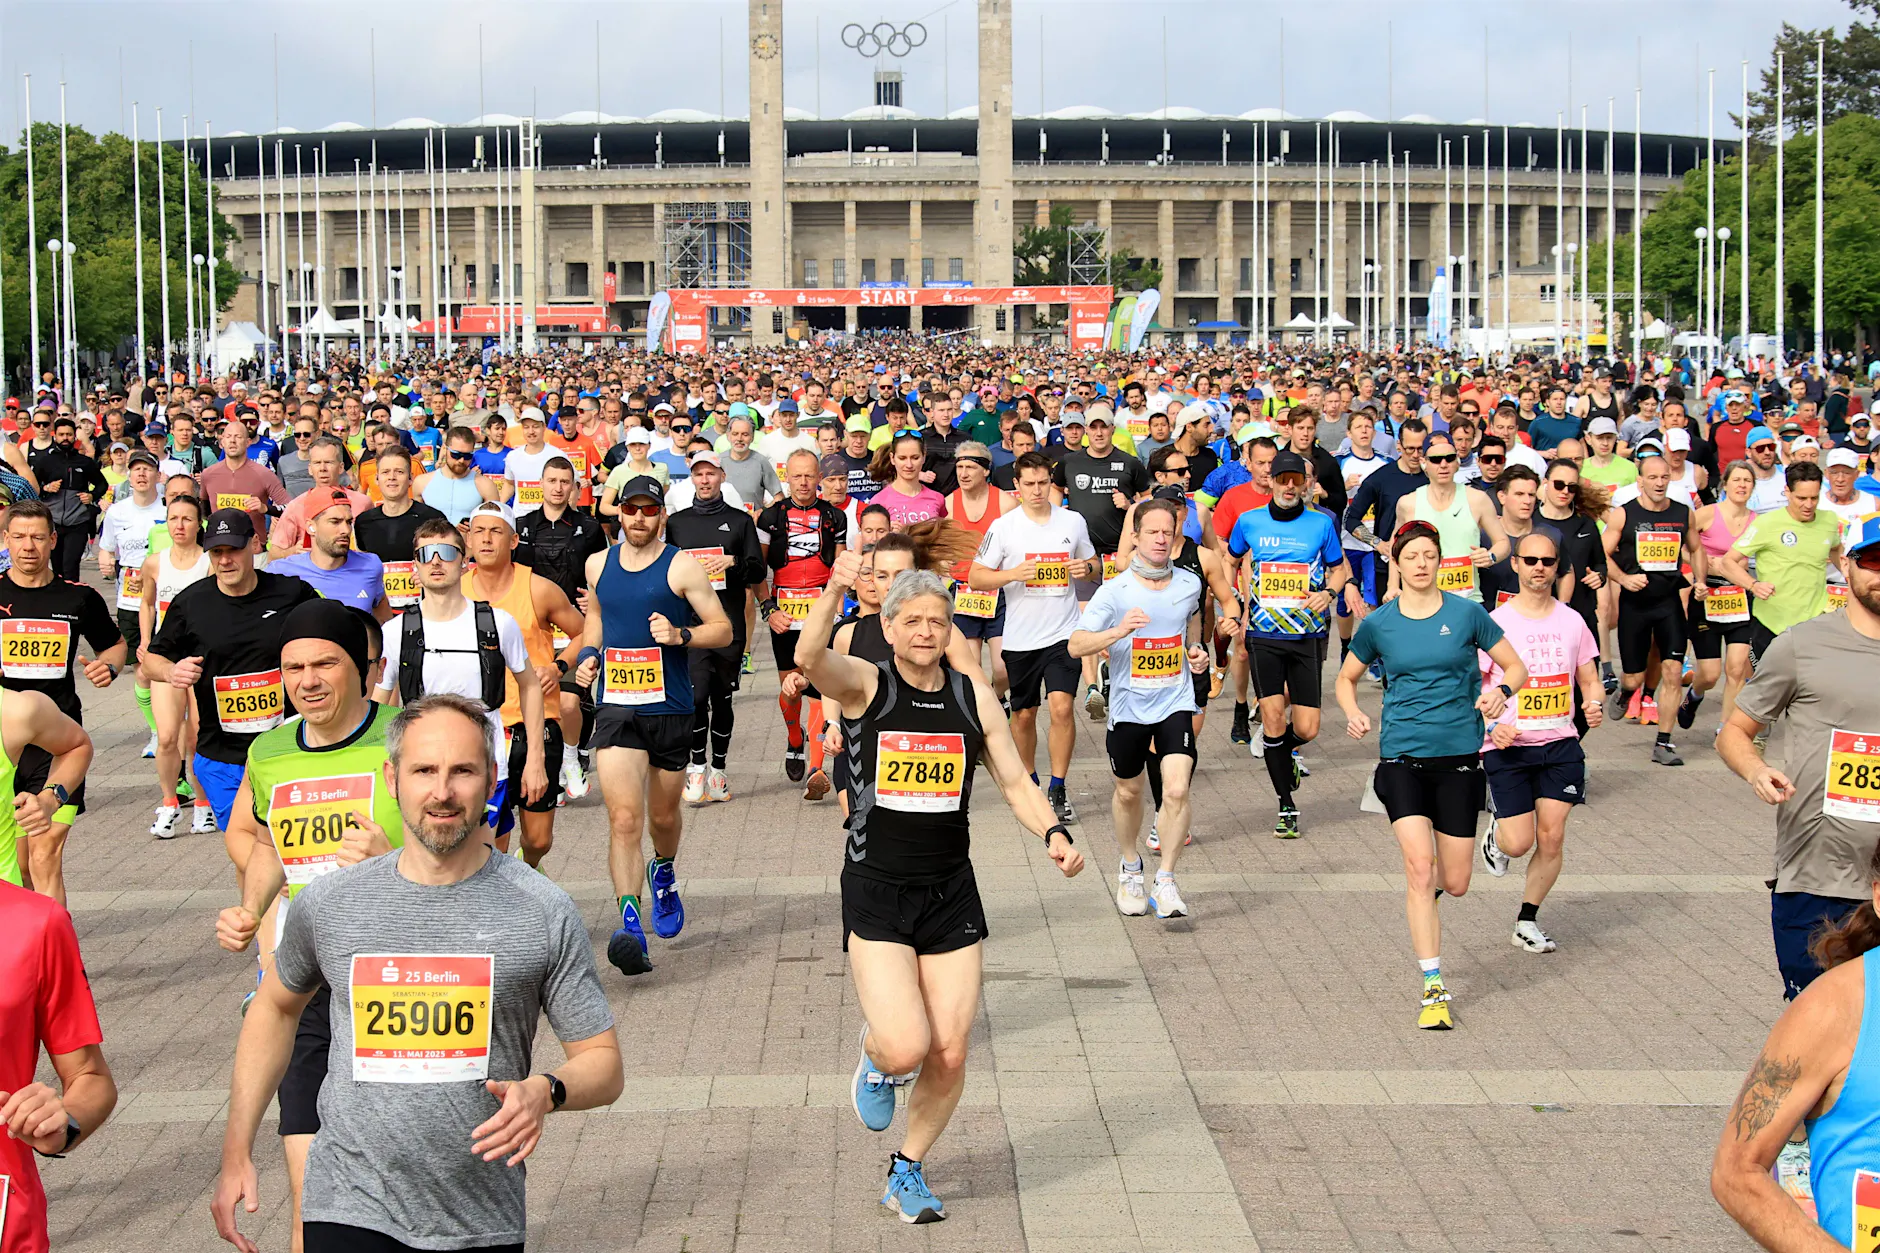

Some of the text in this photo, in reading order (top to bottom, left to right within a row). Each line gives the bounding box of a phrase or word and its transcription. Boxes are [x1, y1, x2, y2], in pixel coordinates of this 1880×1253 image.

[860, 290, 918, 305] START
[1260, 536, 1280, 547] IVU
[1642, 546, 1675, 557] 28516
[1033, 568, 1066, 580] 6938
[1265, 578, 1303, 591] 29494
[959, 598, 992, 611] 28563
[1710, 599, 1742, 610] 28864
[1526, 634, 1562, 643] OWN
[9, 640, 61, 657] 28872
[1529, 648, 1563, 658] THE
[1138, 653, 1178, 670] 29344
[1528, 662, 1564, 674] CITY
[612, 668, 655, 684] 29175
[225, 692, 278, 713] 26368
[912, 700, 944, 709] hummel
[1524, 692, 1567, 710] 26717
[887, 761, 954, 784] 27848
[1838, 762, 1880, 790] 283
[306, 790, 348, 802] 25 Berlin
[405, 971, 460, 982] 25 Berlin
[366, 1001, 474, 1035] 25906
[426, 1050, 446, 1058] 2025
[1858, 1223, 1868, 1232] B2
